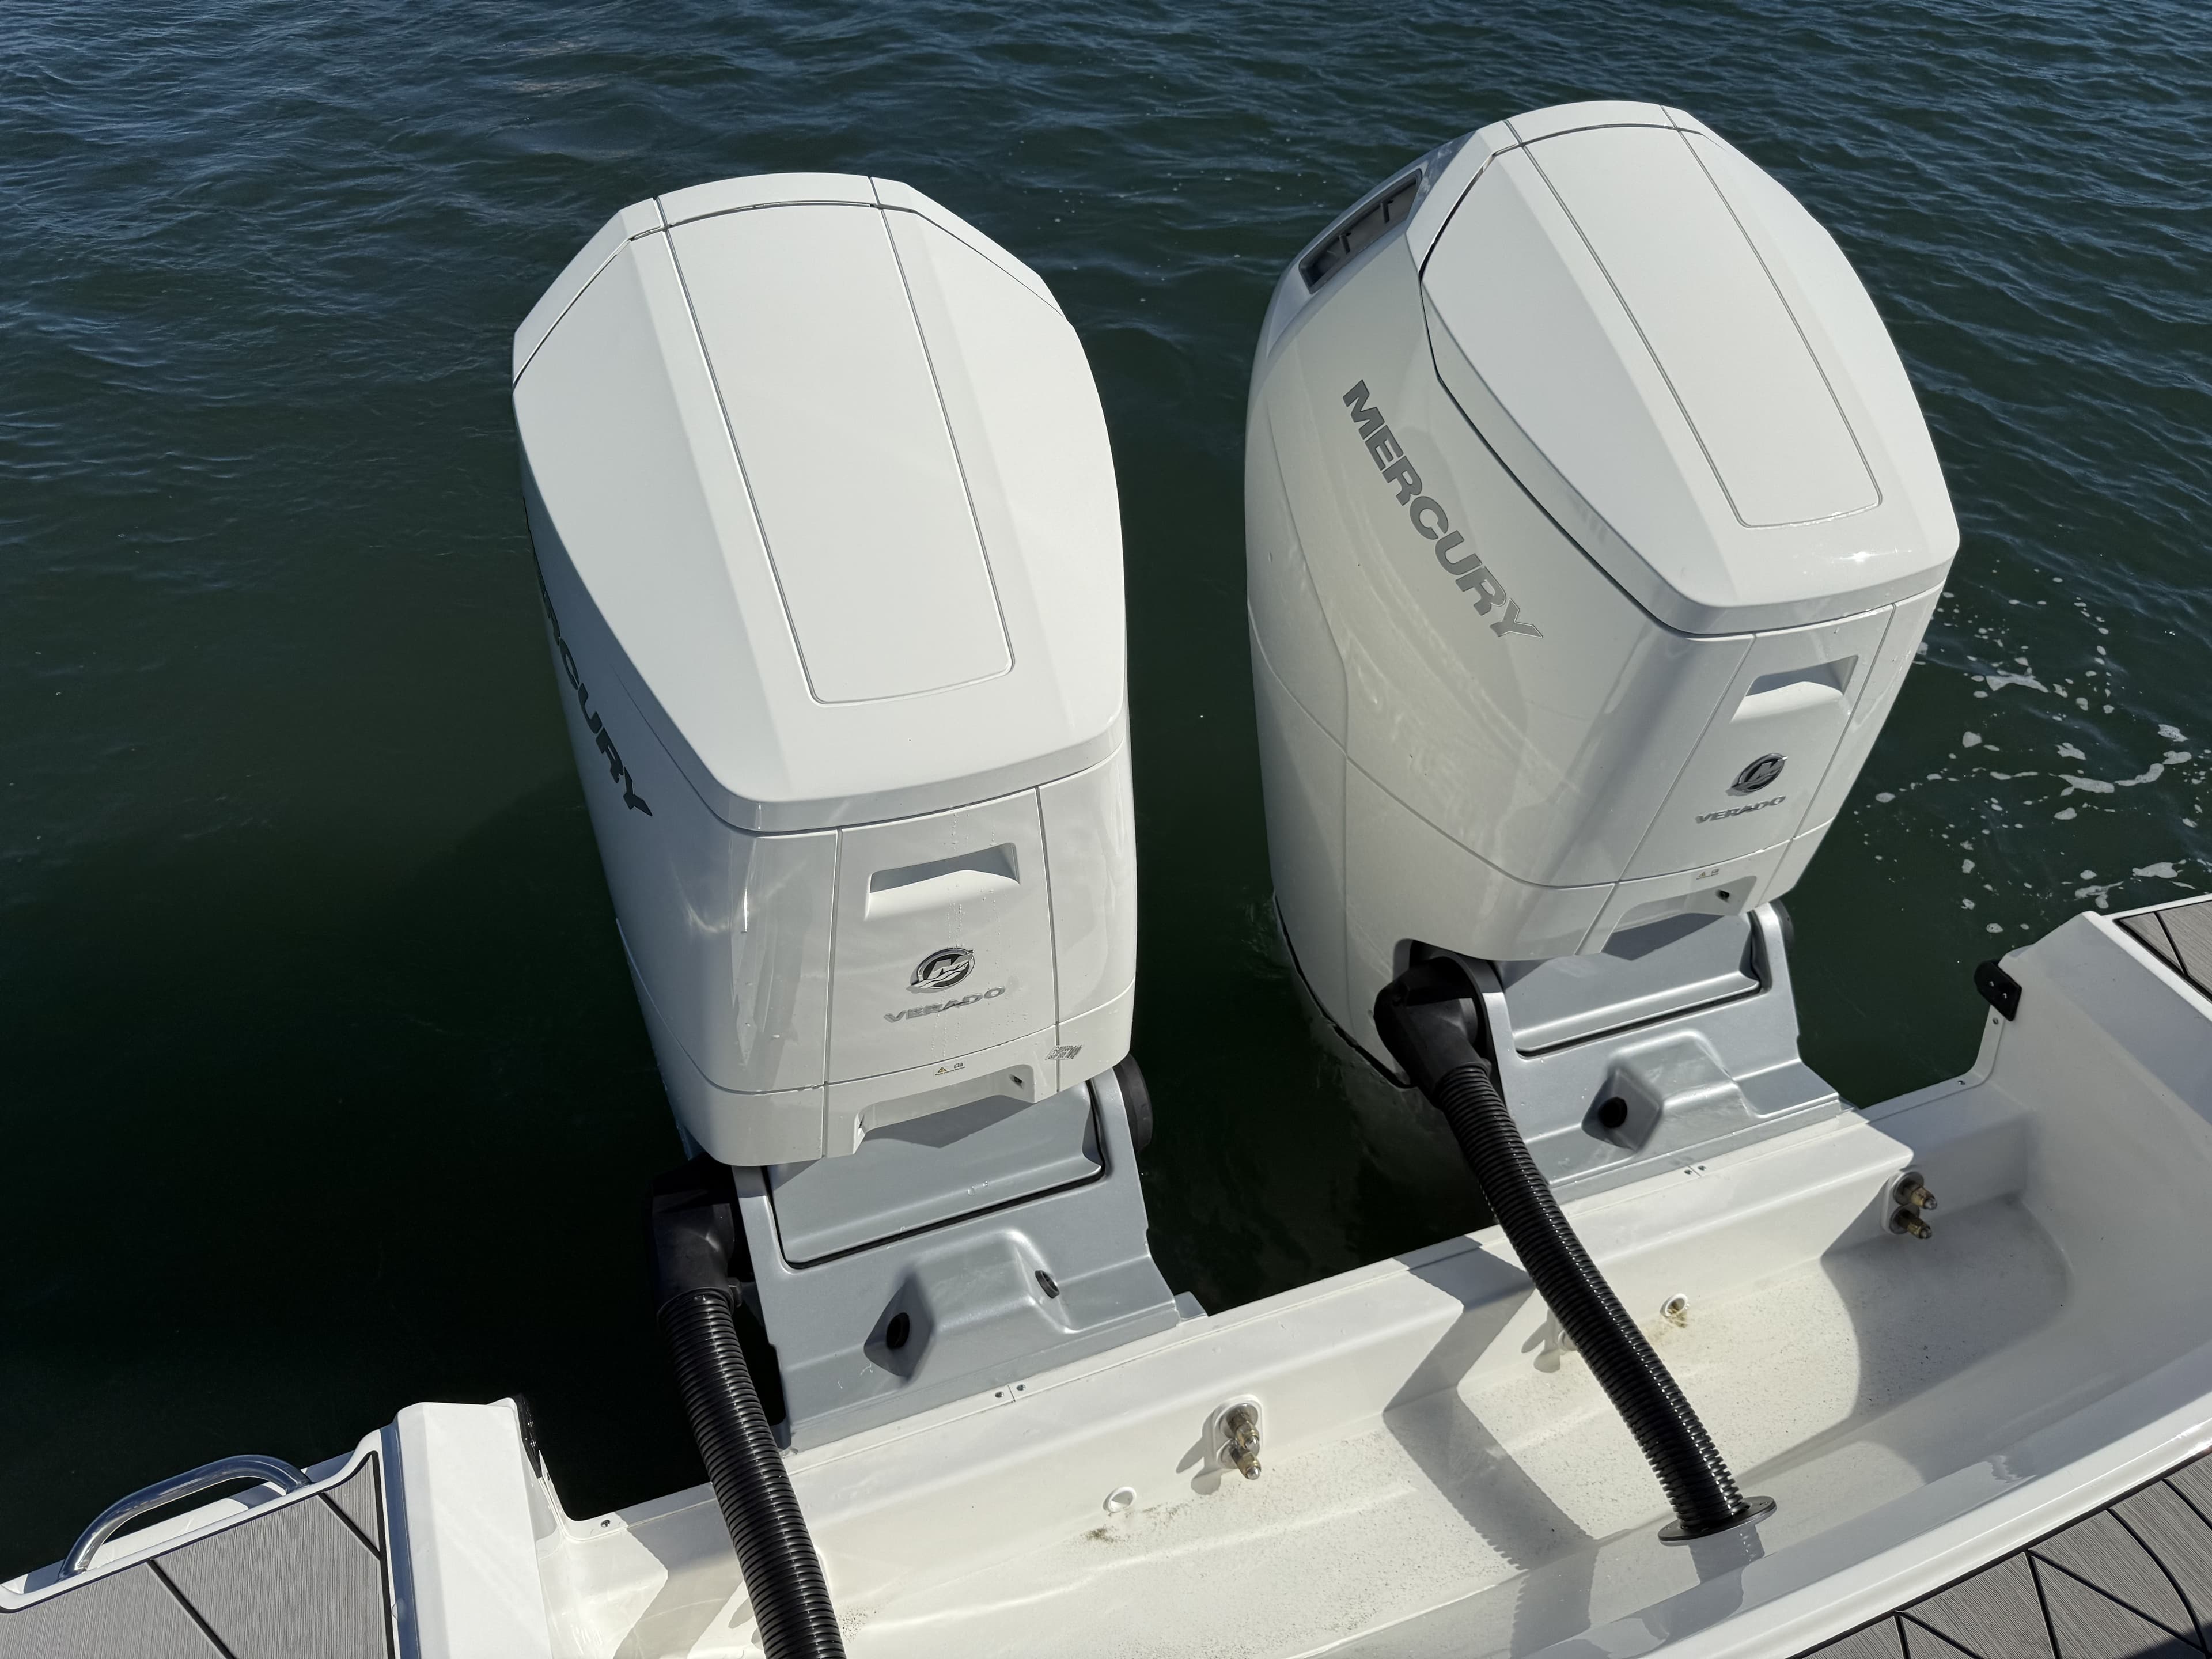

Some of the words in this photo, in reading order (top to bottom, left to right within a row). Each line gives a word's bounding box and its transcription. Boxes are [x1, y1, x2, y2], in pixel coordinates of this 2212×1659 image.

[1343, 379, 1543, 638] MERCURY
[1695, 795, 1786, 824] VERADO
[884, 986, 1006, 1023] VERADO
